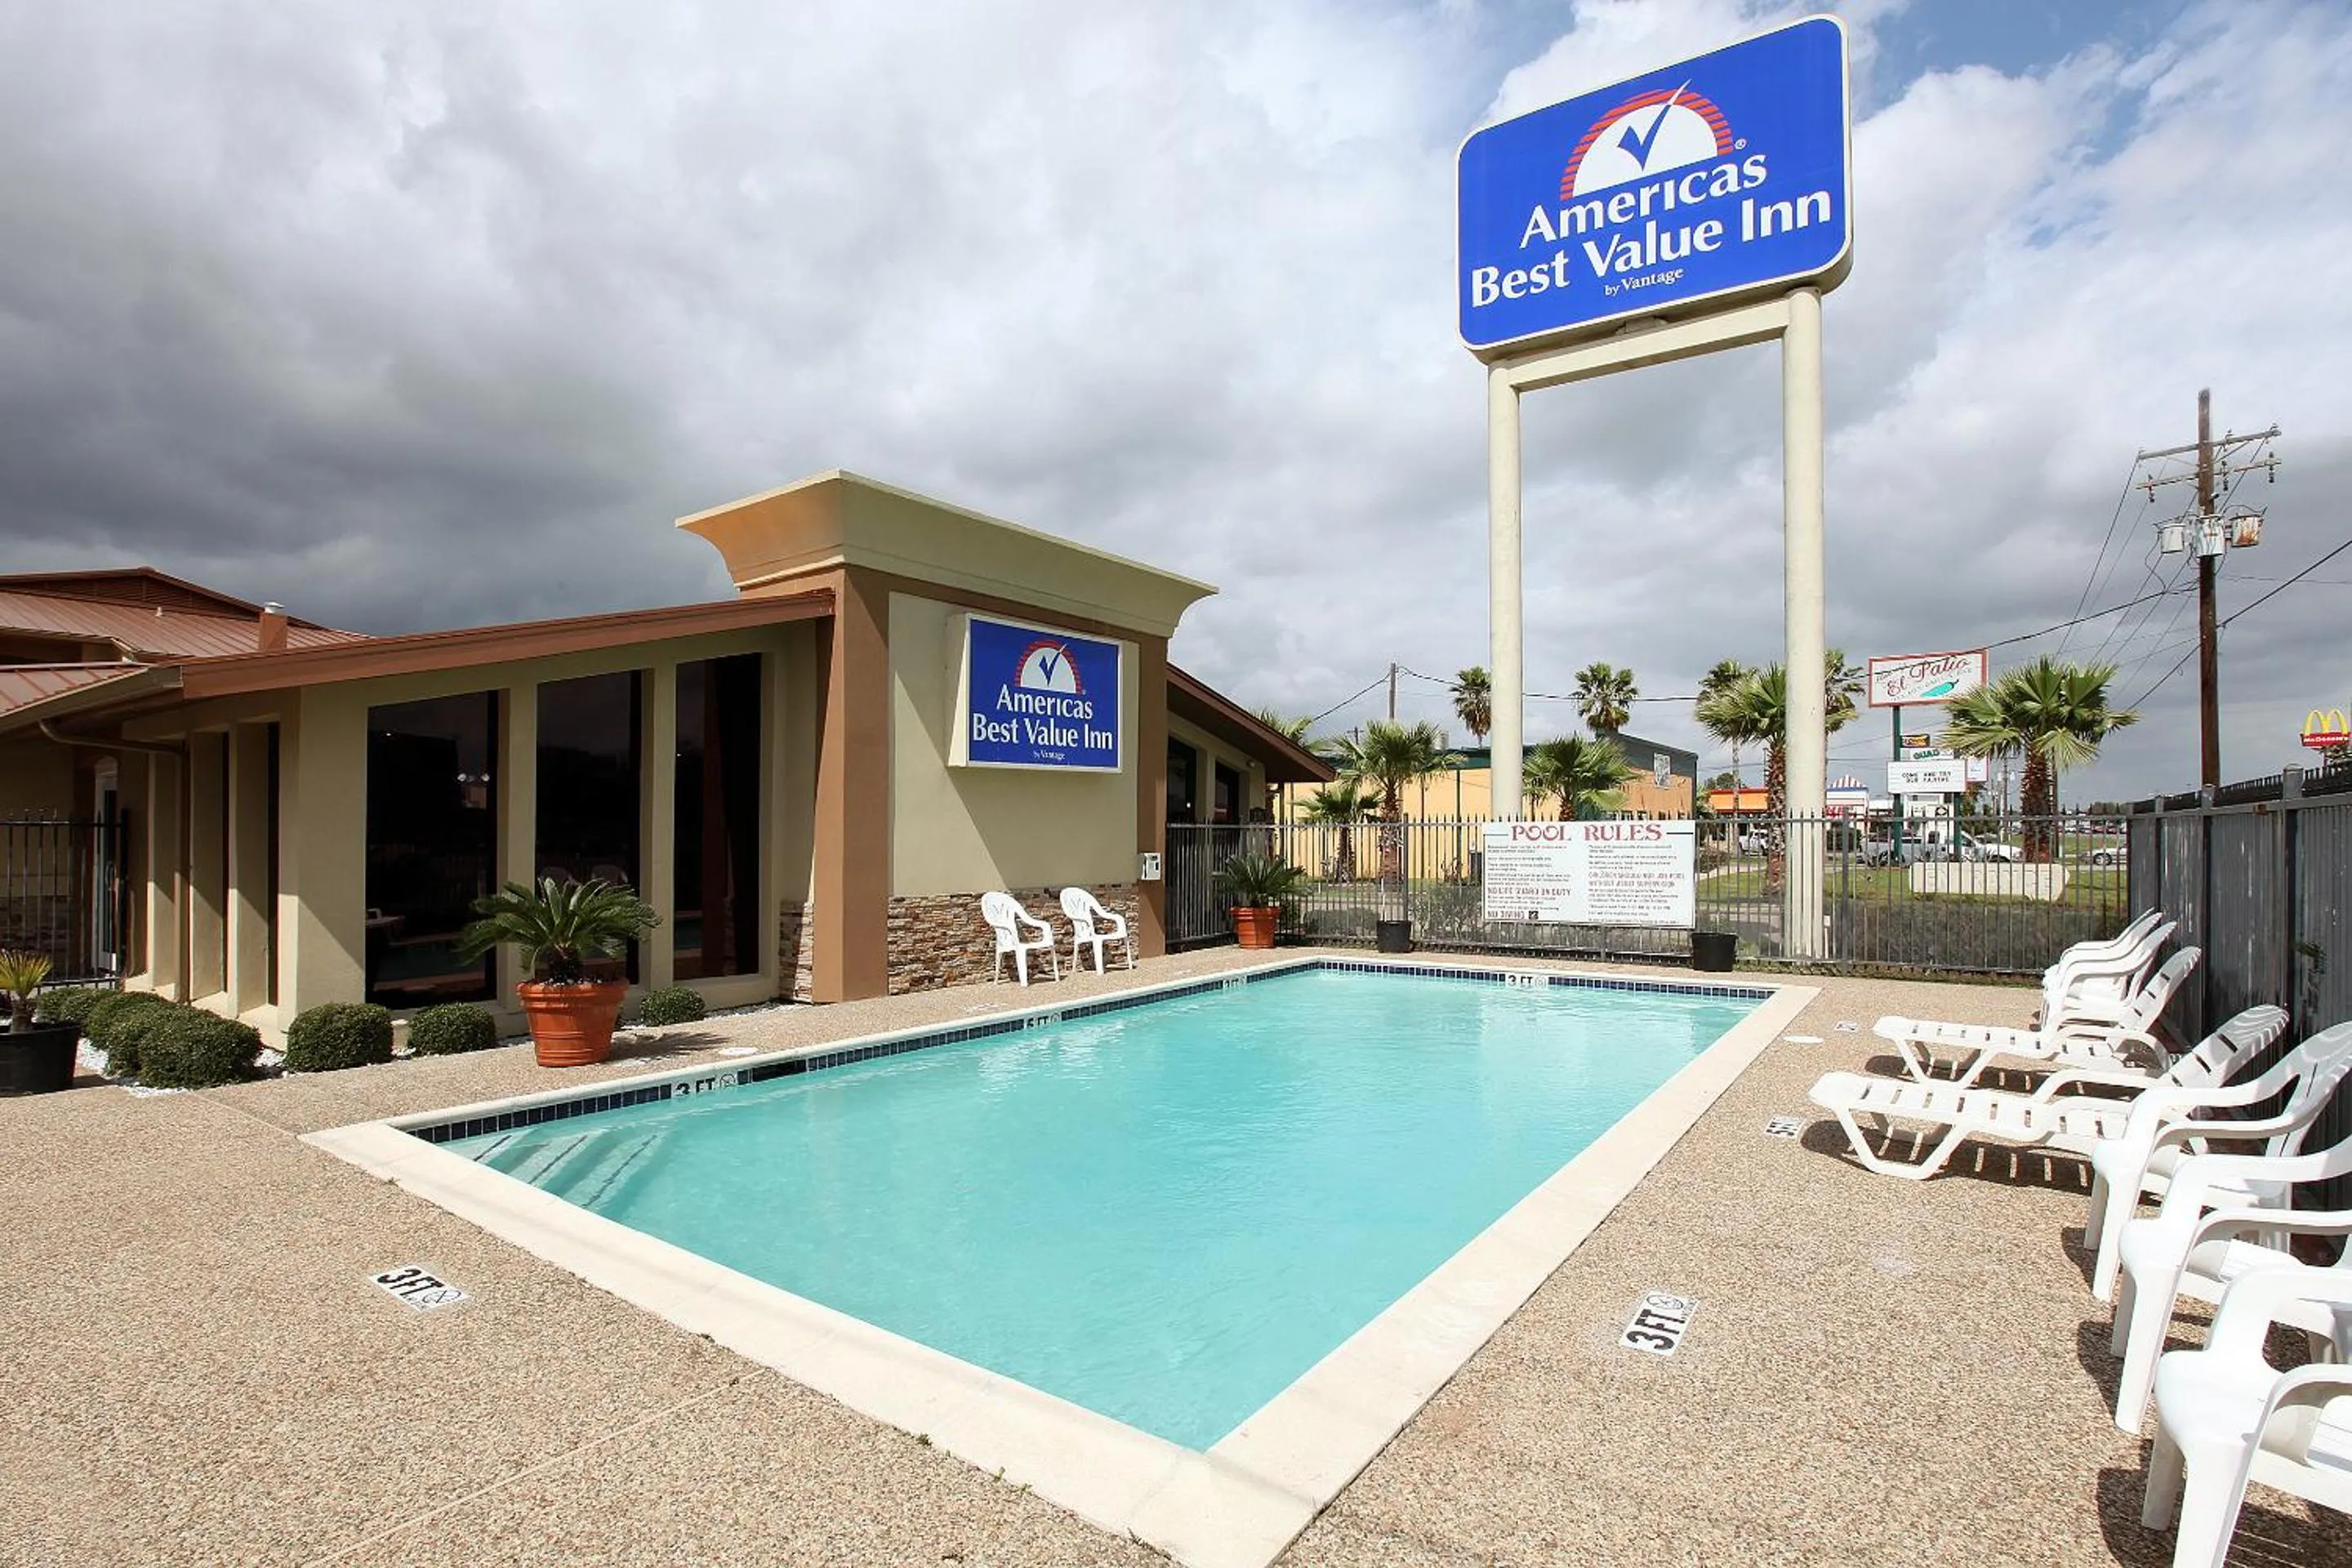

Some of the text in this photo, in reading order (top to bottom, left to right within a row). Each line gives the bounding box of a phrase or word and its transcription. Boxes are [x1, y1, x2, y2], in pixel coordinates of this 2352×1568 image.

[1519, 154, 1767, 248] Americas
[1472, 191, 1831, 308] Best Value Inn
[1604, 268, 1685, 297] by Vantage
[1886, 675, 1907, 697] El
[1909, 656, 1971, 683] Patio
[996, 684, 1094, 719] Americas
[973, 713, 1113, 750] Best Value Inn
[1511, 824, 1663, 841] POOL RULES
[376, 1268, 445, 1296] 3FT
[1626, 1308, 1686, 1350] 3FT
